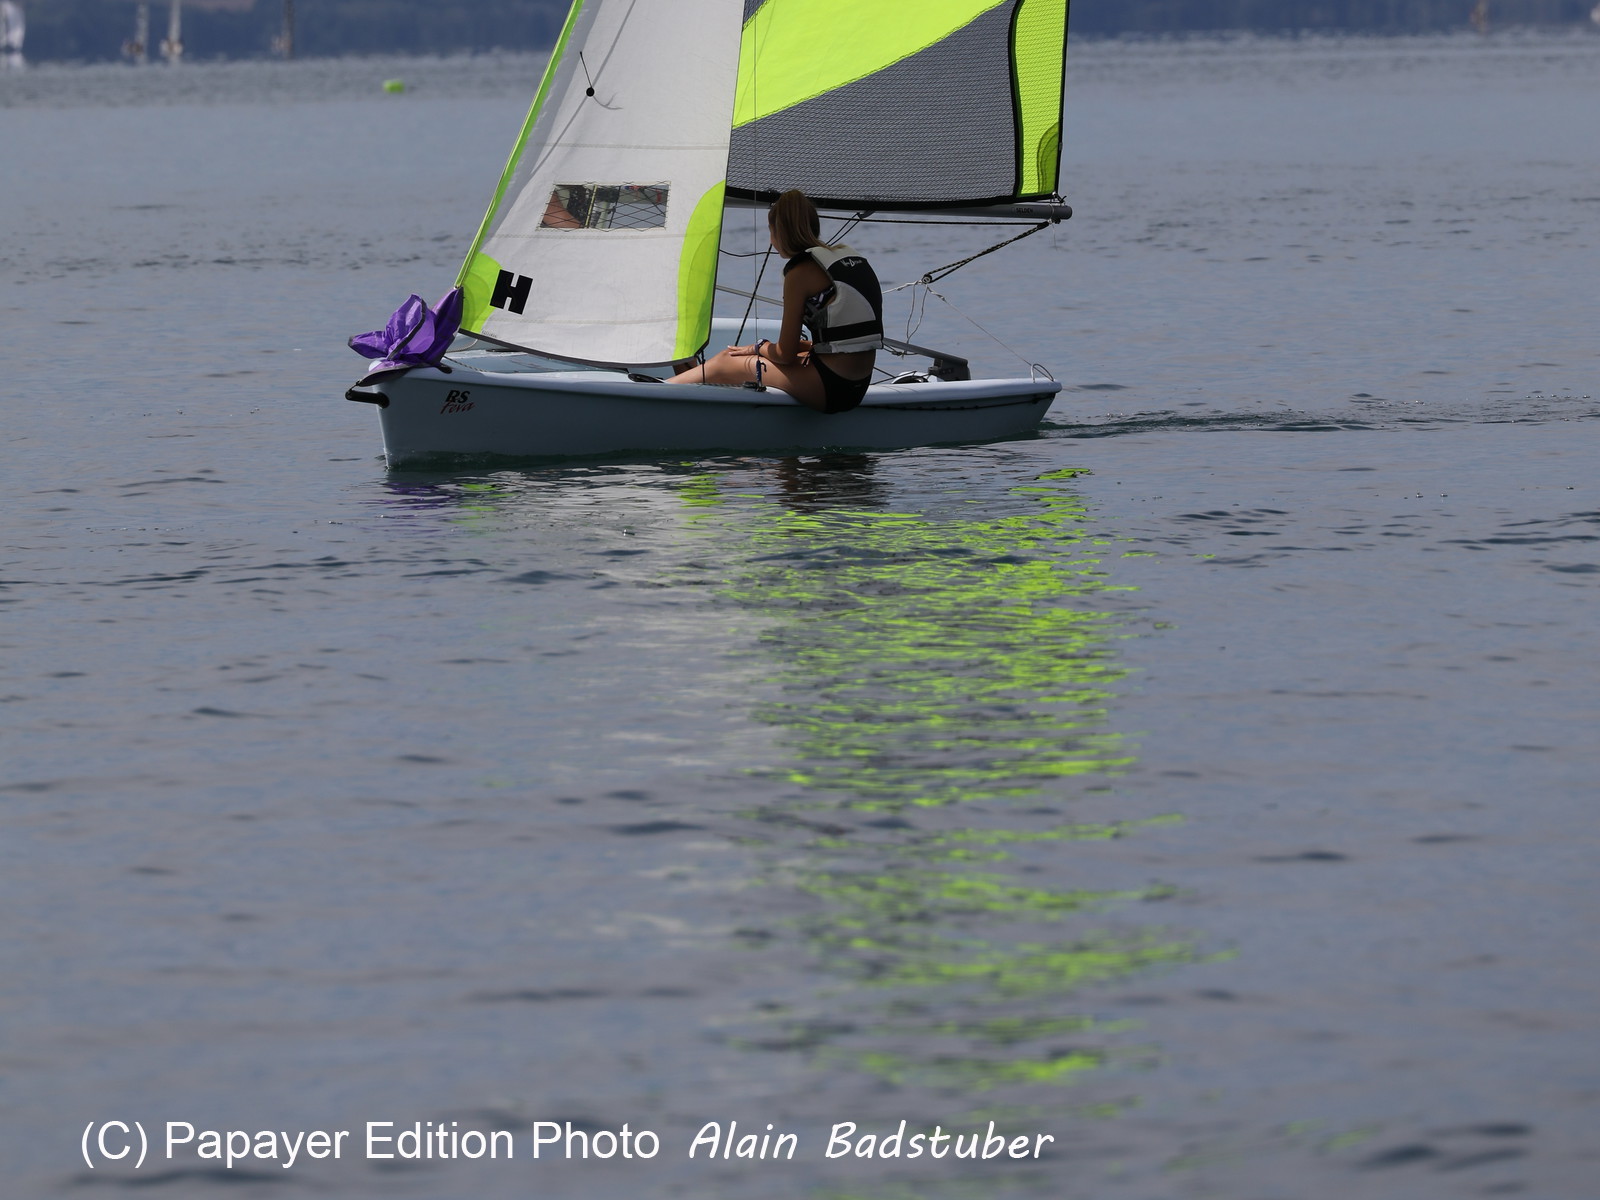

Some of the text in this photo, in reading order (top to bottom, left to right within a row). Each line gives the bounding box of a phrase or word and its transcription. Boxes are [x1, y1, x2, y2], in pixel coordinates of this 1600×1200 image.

[489, 269, 533, 315] H
[445, 390, 470, 404] RS
[440, 400, 475, 414] Feva
